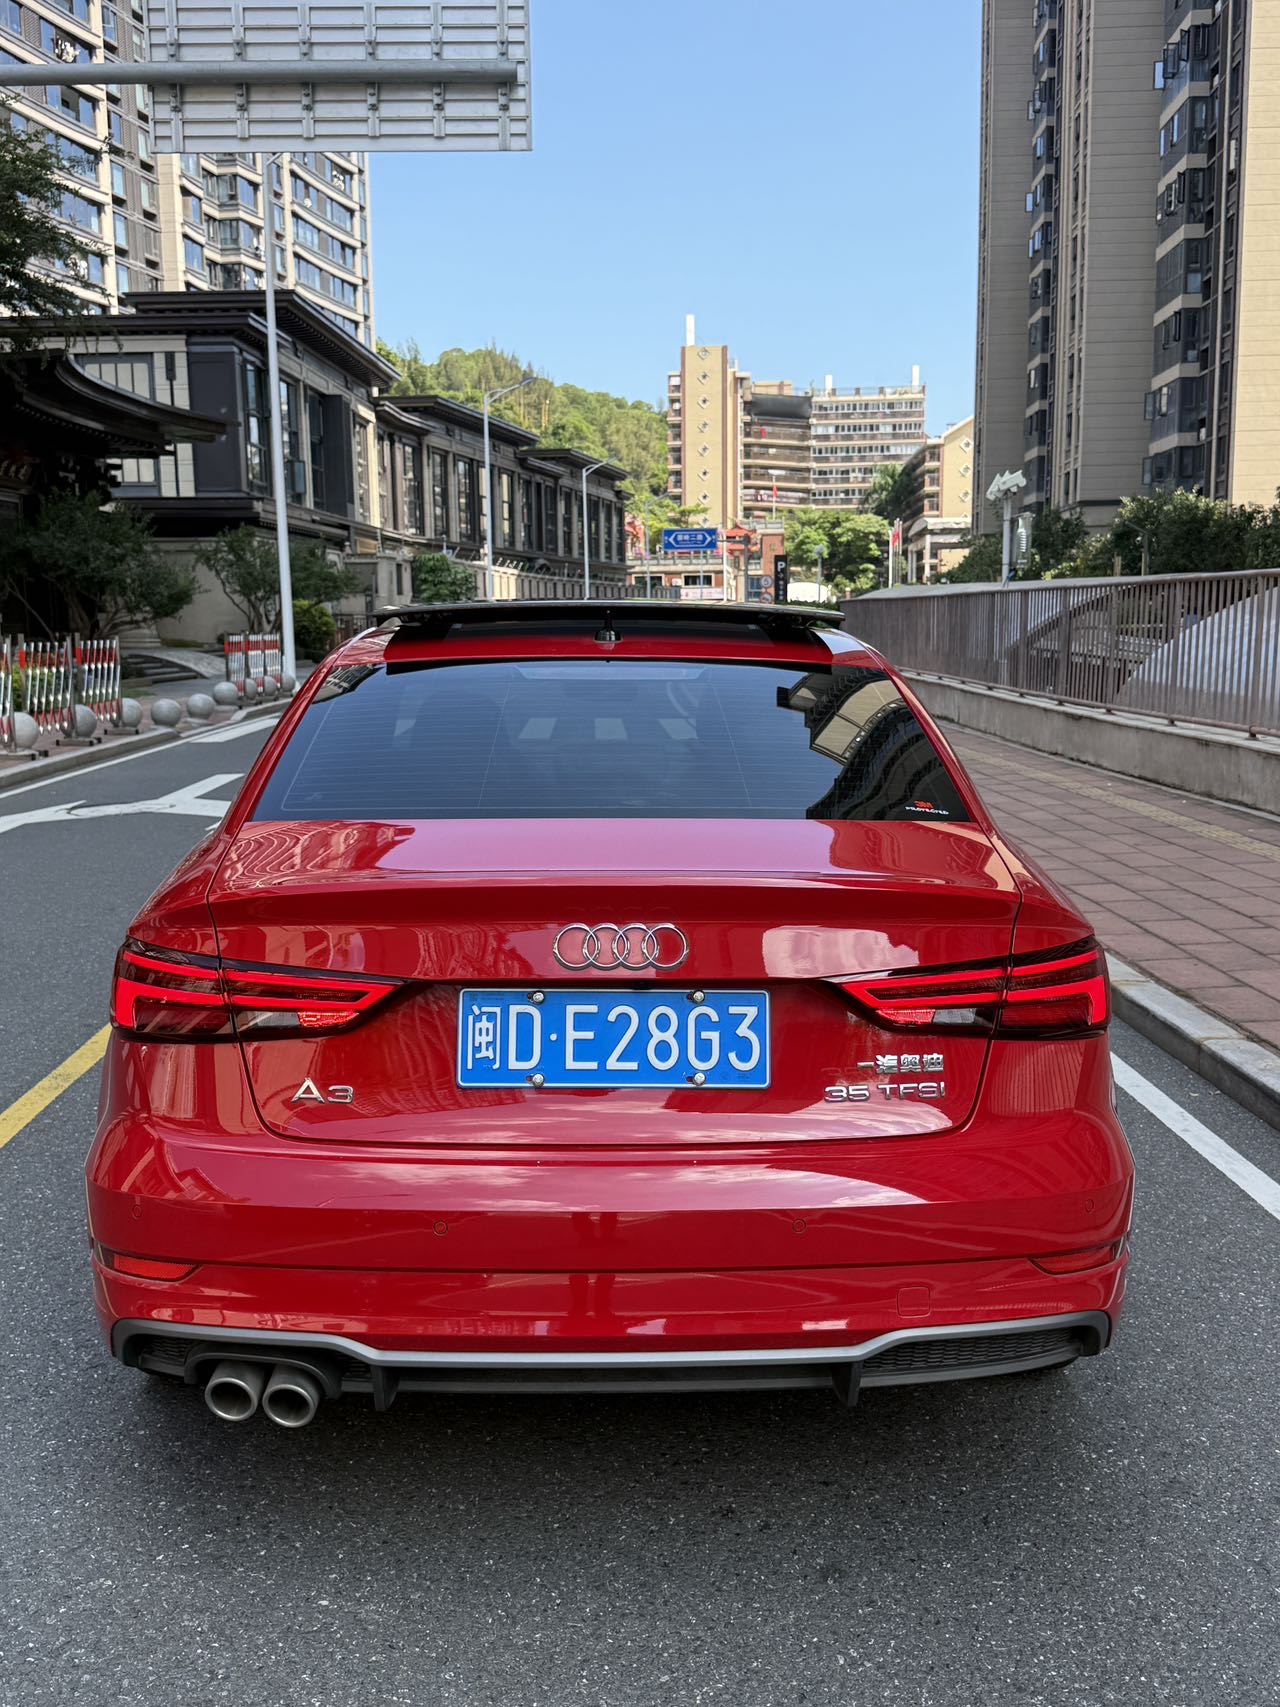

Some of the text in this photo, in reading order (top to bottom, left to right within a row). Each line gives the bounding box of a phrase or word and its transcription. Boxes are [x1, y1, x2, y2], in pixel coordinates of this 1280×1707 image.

[777, 561, 786, 572] P
[857, 1053, 944, 1073] 一汽奥迪
[291, 1077, 354, 1104] A3
[824, 1081, 946, 1102] 35 TFSI
